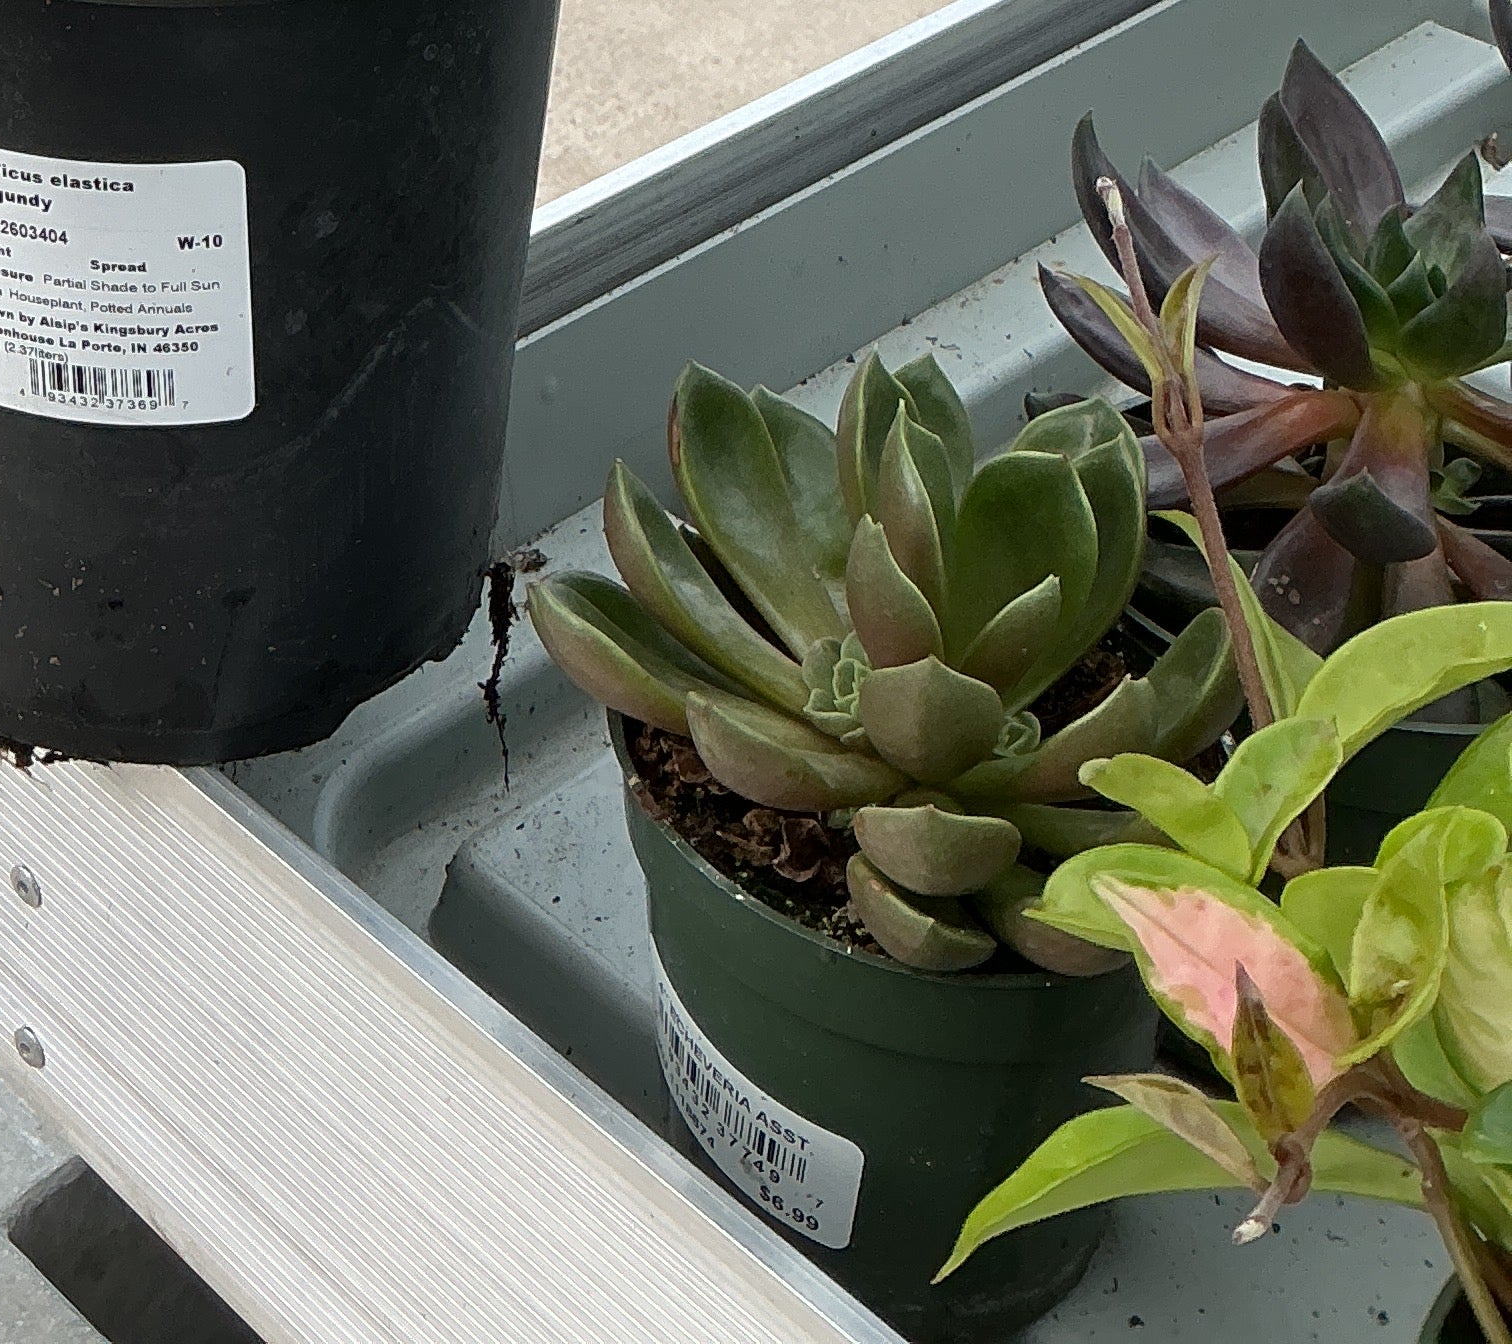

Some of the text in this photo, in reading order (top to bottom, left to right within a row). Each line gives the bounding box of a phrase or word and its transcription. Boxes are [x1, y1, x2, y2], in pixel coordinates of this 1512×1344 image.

[50, 174, 135, 192] elastica
[0, 220, 68, 245] 2603404
[177, 234, 223, 250] W-10
[90, 259, 147, 273] Spread
[43, 274, 86, 290] Partial
[90, 280, 138, 293] Shade
[142, 283, 156, 293] to
[161, 281, 187, 293] Full
[191, 280, 220, 291] Sun
[90, 301, 133, 314] Potted
[137, 303, 193, 314] Annuals
[19, 312, 35, 326] by
[93, 323, 169, 337] Kingsbury
[175, 324, 219, 334] Acres
[59, 337, 76, 349] La
[81, 340, 126, 355] Porte,
[131, 343, 147, 353] IN
[153, 341, 199, 353] 46350
[48, 391, 99, 408] 93432
[759, 1185, 819, 1230] $6.99
